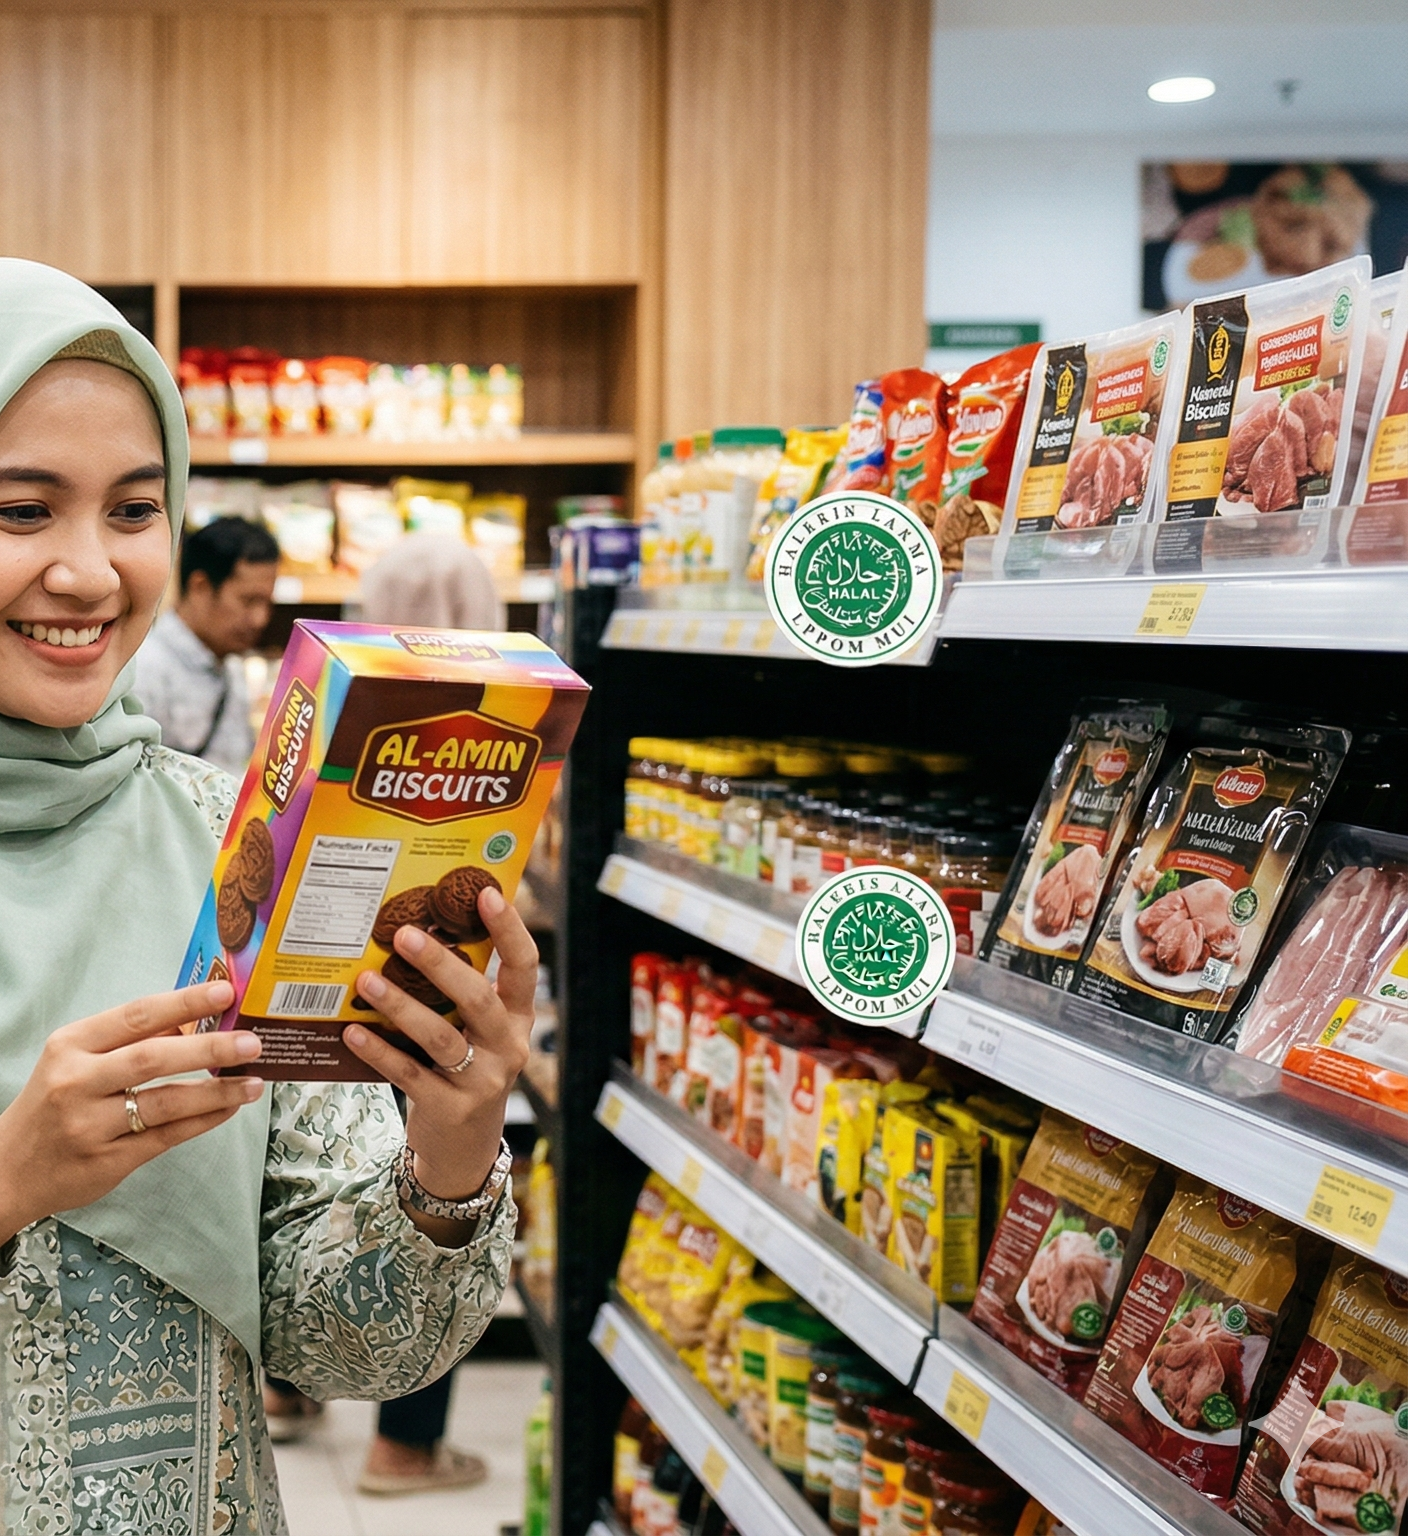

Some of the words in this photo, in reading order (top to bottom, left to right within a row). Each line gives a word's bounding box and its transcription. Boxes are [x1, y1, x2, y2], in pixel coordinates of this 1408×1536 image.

[826, 553, 882, 586] حلال
[829, 587, 880, 600] HALAL
[792, 612, 863, 654] LPPOM
[877, 614, 915, 650] MUI
[265, 689, 304, 791] AL-AMIN
[275, 701, 314, 803] BISCUITS
[376, 733, 528, 772] AL-AMIN
[371, 769, 512, 804] BISCUITS
[819, 975, 886, 1014] LPPOM
[895, 977, 930, 1010] MUI
